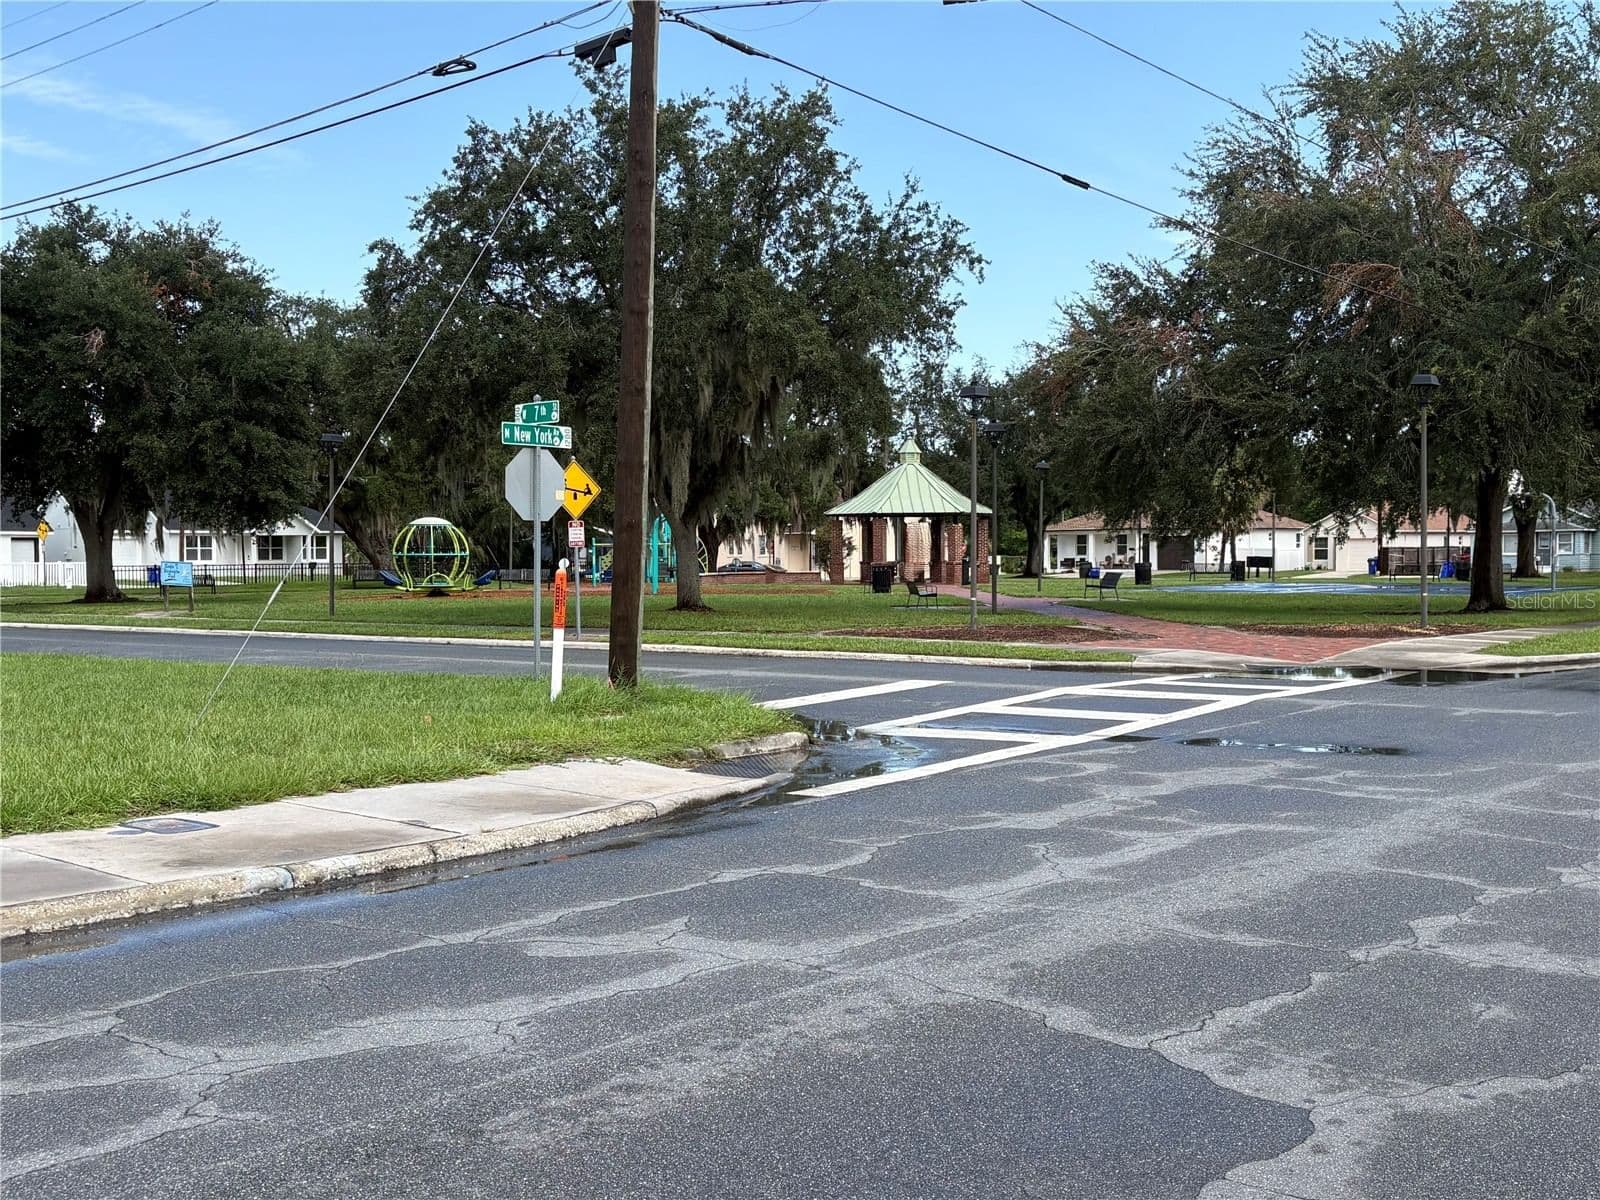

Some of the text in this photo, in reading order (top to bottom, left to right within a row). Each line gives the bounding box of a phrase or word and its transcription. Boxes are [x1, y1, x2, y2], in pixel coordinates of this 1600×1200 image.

[534, 404, 547, 421] 7th
[504, 427, 510, 439] N
[514, 426, 532, 442] New
[534, 427, 553, 444] York
